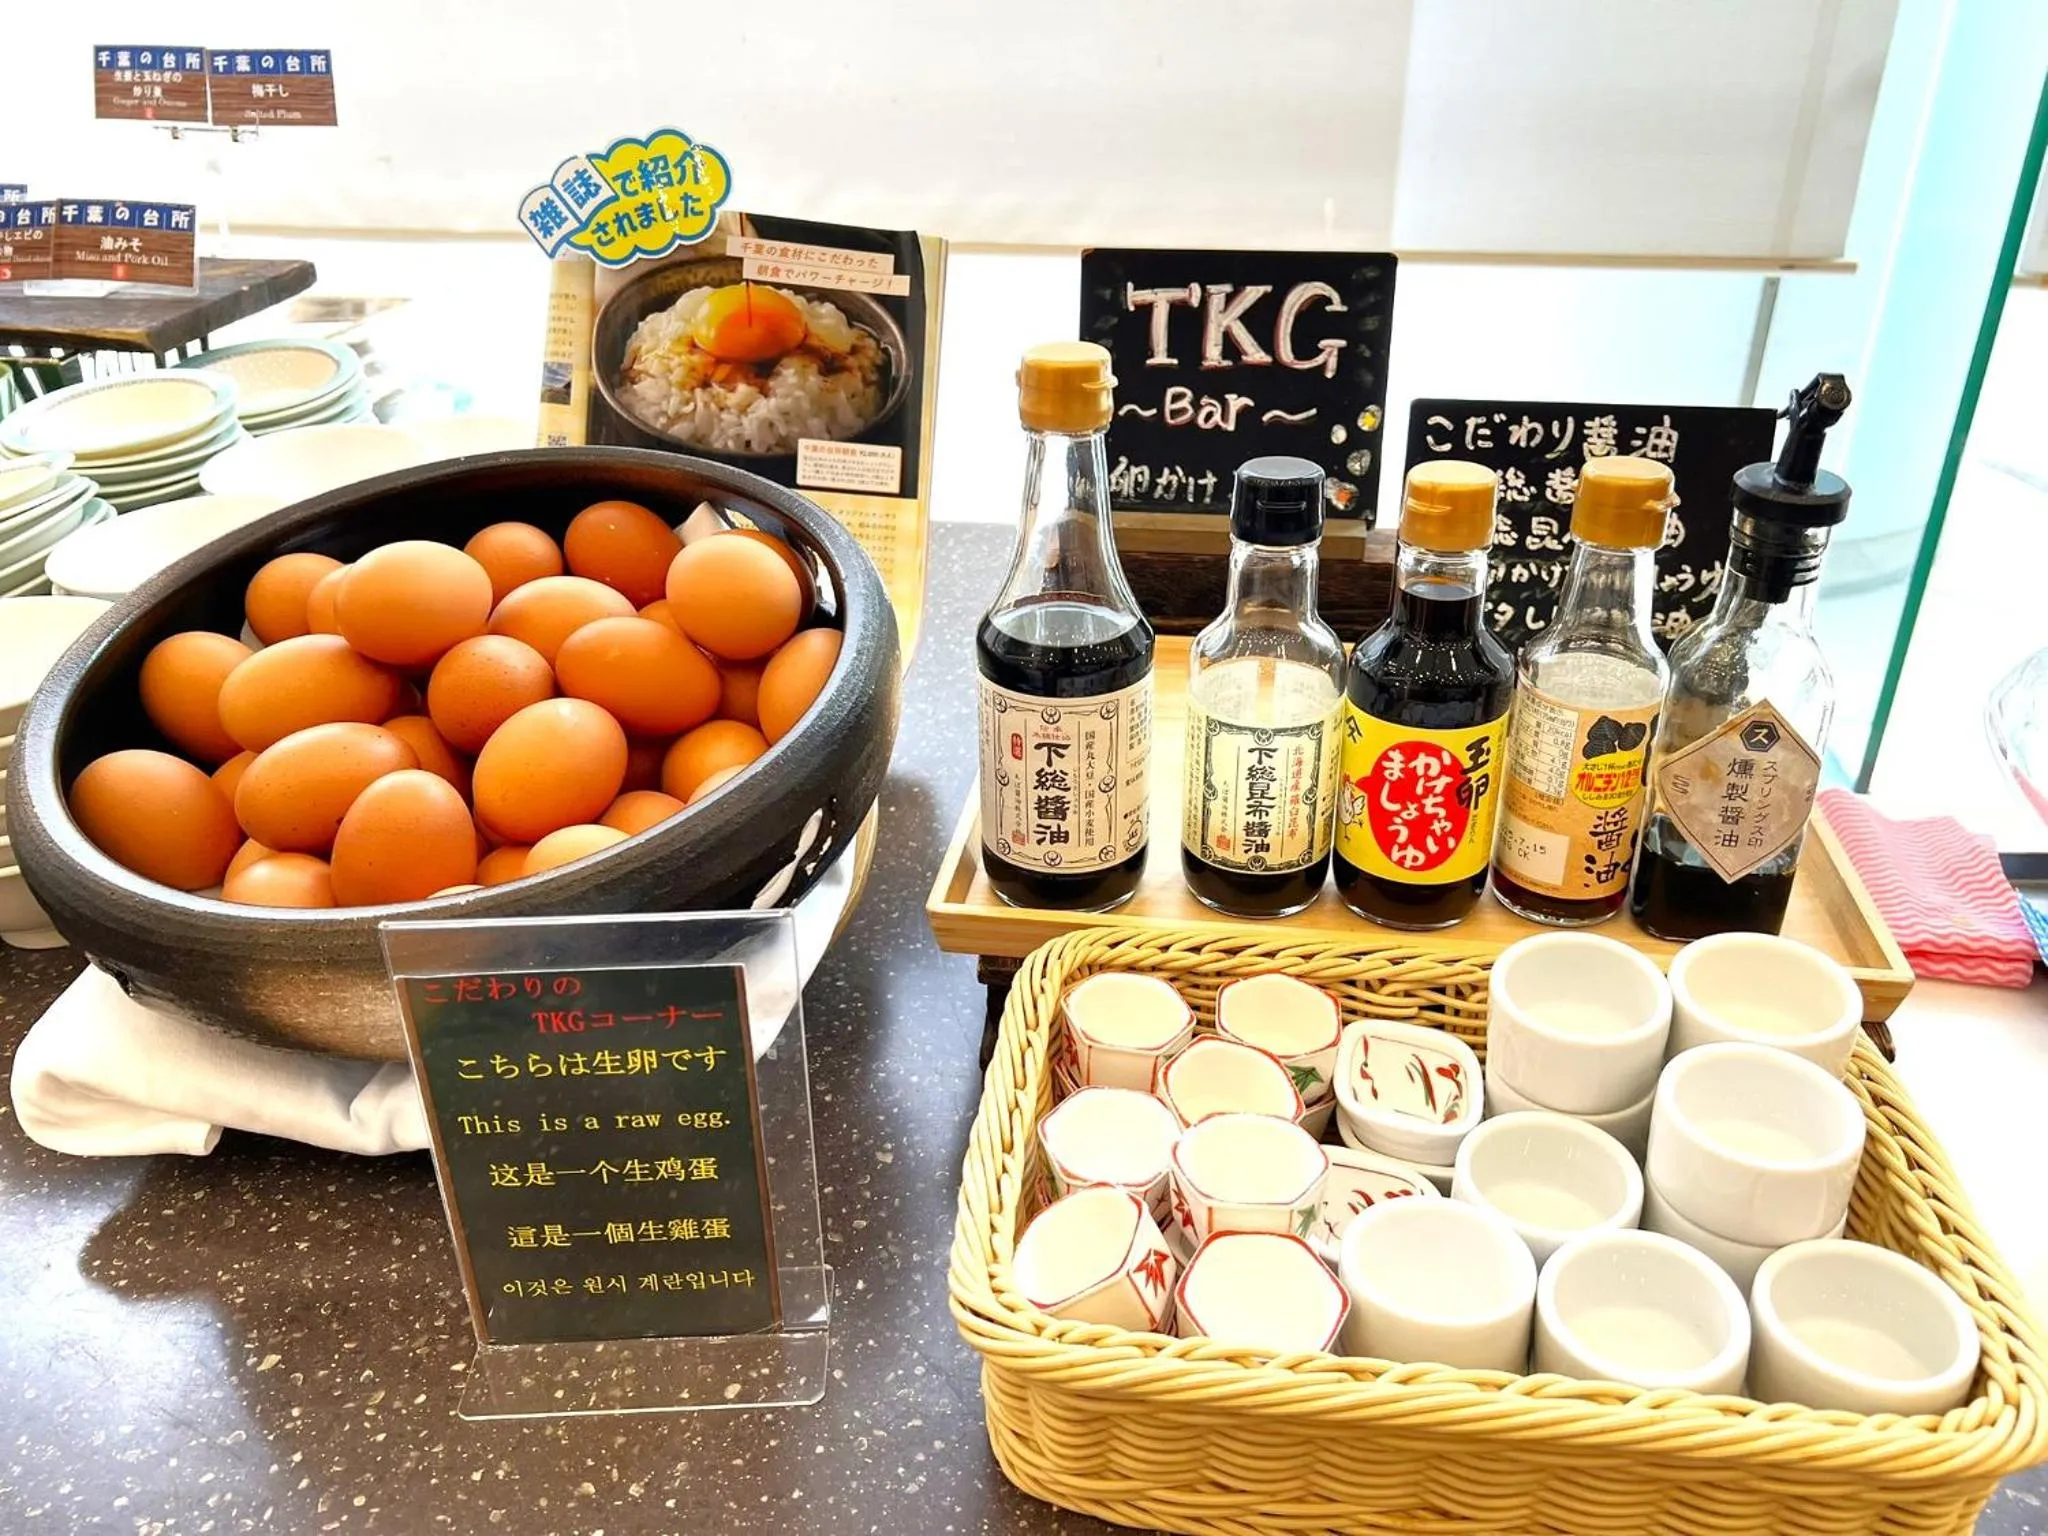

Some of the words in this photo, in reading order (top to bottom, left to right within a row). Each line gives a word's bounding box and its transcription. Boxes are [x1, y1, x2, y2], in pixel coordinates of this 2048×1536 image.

[98, 50, 201, 70] 千葉の台所
[213, 54, 328, 73] 千葉の台所
[251, 83, 290, 98] 梅干し
[62, 204, 191, 229] 千葉の台所
[591, 191, 704, 247] されました
[100, 236, 143, 252] 油みそ
[102, 251, 121, 263] and
[123, 252, 150, 265] Pork
[741, 241, 880, 270] 千葉の食材にこだわった
[1123, 280, 1349, 379] TKG
[1749, 728, 1770, 744] ス
[1747, 761, 1779, 849] スプリングス印
[423, 975, 582, 1002] こだわりの
[531, 1005, 725, 1034] TKGコーナー
[457, 1045, 727, 1080] こちらは生卵です
[458, 1115, 521, 1135] This
[540, 1112, 568, 1132] is
[584, 1117, 600, 1130] a
[615, 1114, 661, 1129] raw
[677, 1112, 732, 1129] egg.
[488, 1157, 719, 1188] 这是一个生鸡蛋
[507, 1217, 731, 1249] 這是一個生雞蛋
[503, 1278, 574, 1298] 이것은
[582, 1275, 628, 1294] 원시
[638, 1268, 757, 1292] 계란입니다
